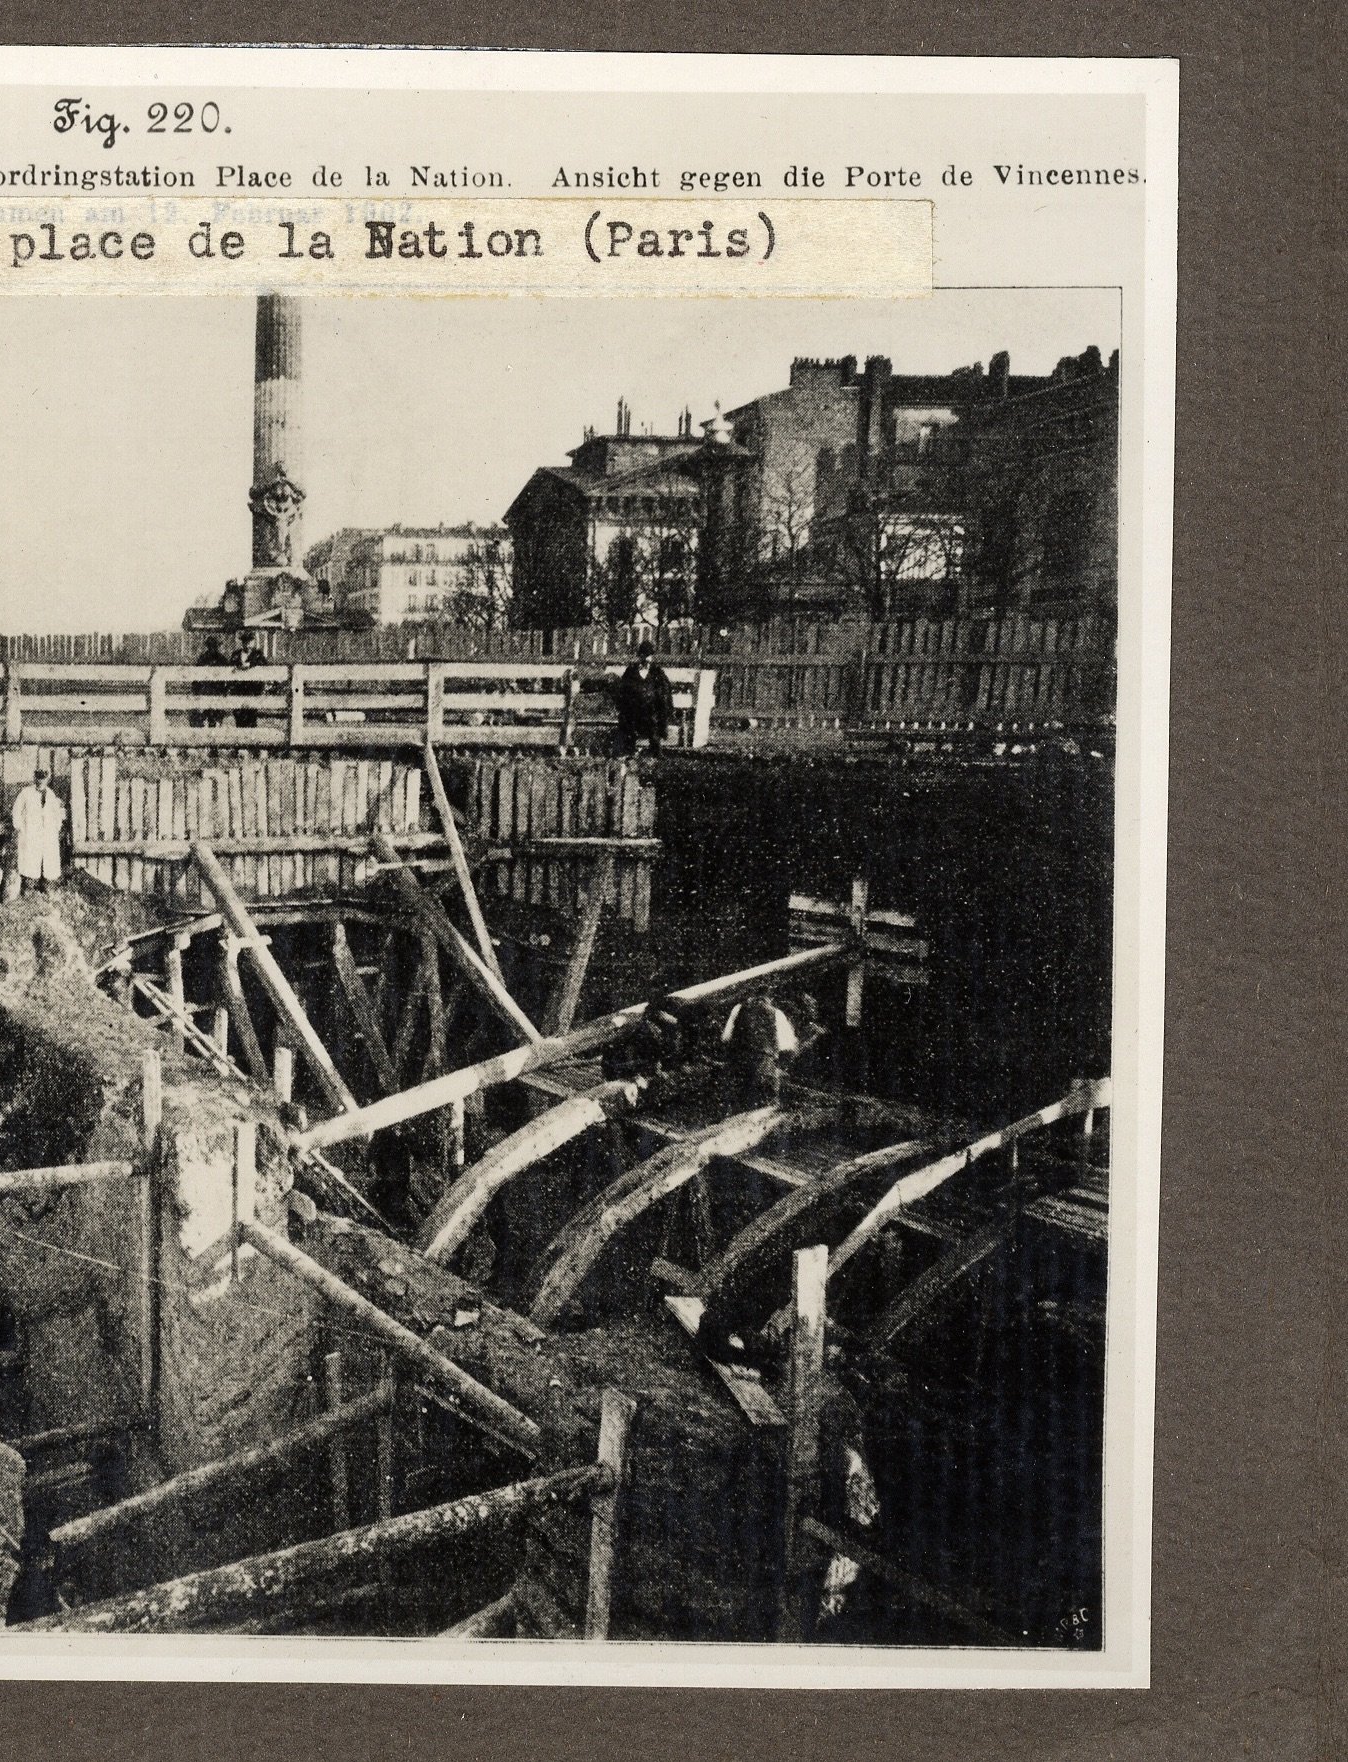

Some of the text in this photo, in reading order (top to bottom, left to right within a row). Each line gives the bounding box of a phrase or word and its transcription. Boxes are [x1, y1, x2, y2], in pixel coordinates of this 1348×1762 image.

[53, 97, 232, 149] Fig. 220.
[216, 165, 292, 188] Place
[312, 165, 342, 188] de
[365, 165, 390, 187] la
[410, 165, 513, 188] Nation.
[551, 166, 660, 189] Ansicht
[680, 171, 762, 193] gegen
[783, 165, 825, 188] die
[845, 166, 921, 188] Porte
[941, 164, 973, 187] de
[993, 164, 1148, 187] Vincennes.
[9, 223, 156, 268] place
[188, 221, 245, 260] de
[278, 221, 335, 260] la
[364, 220, 543, 259] Nation
[584, 214, 776, 264] (Paris)
